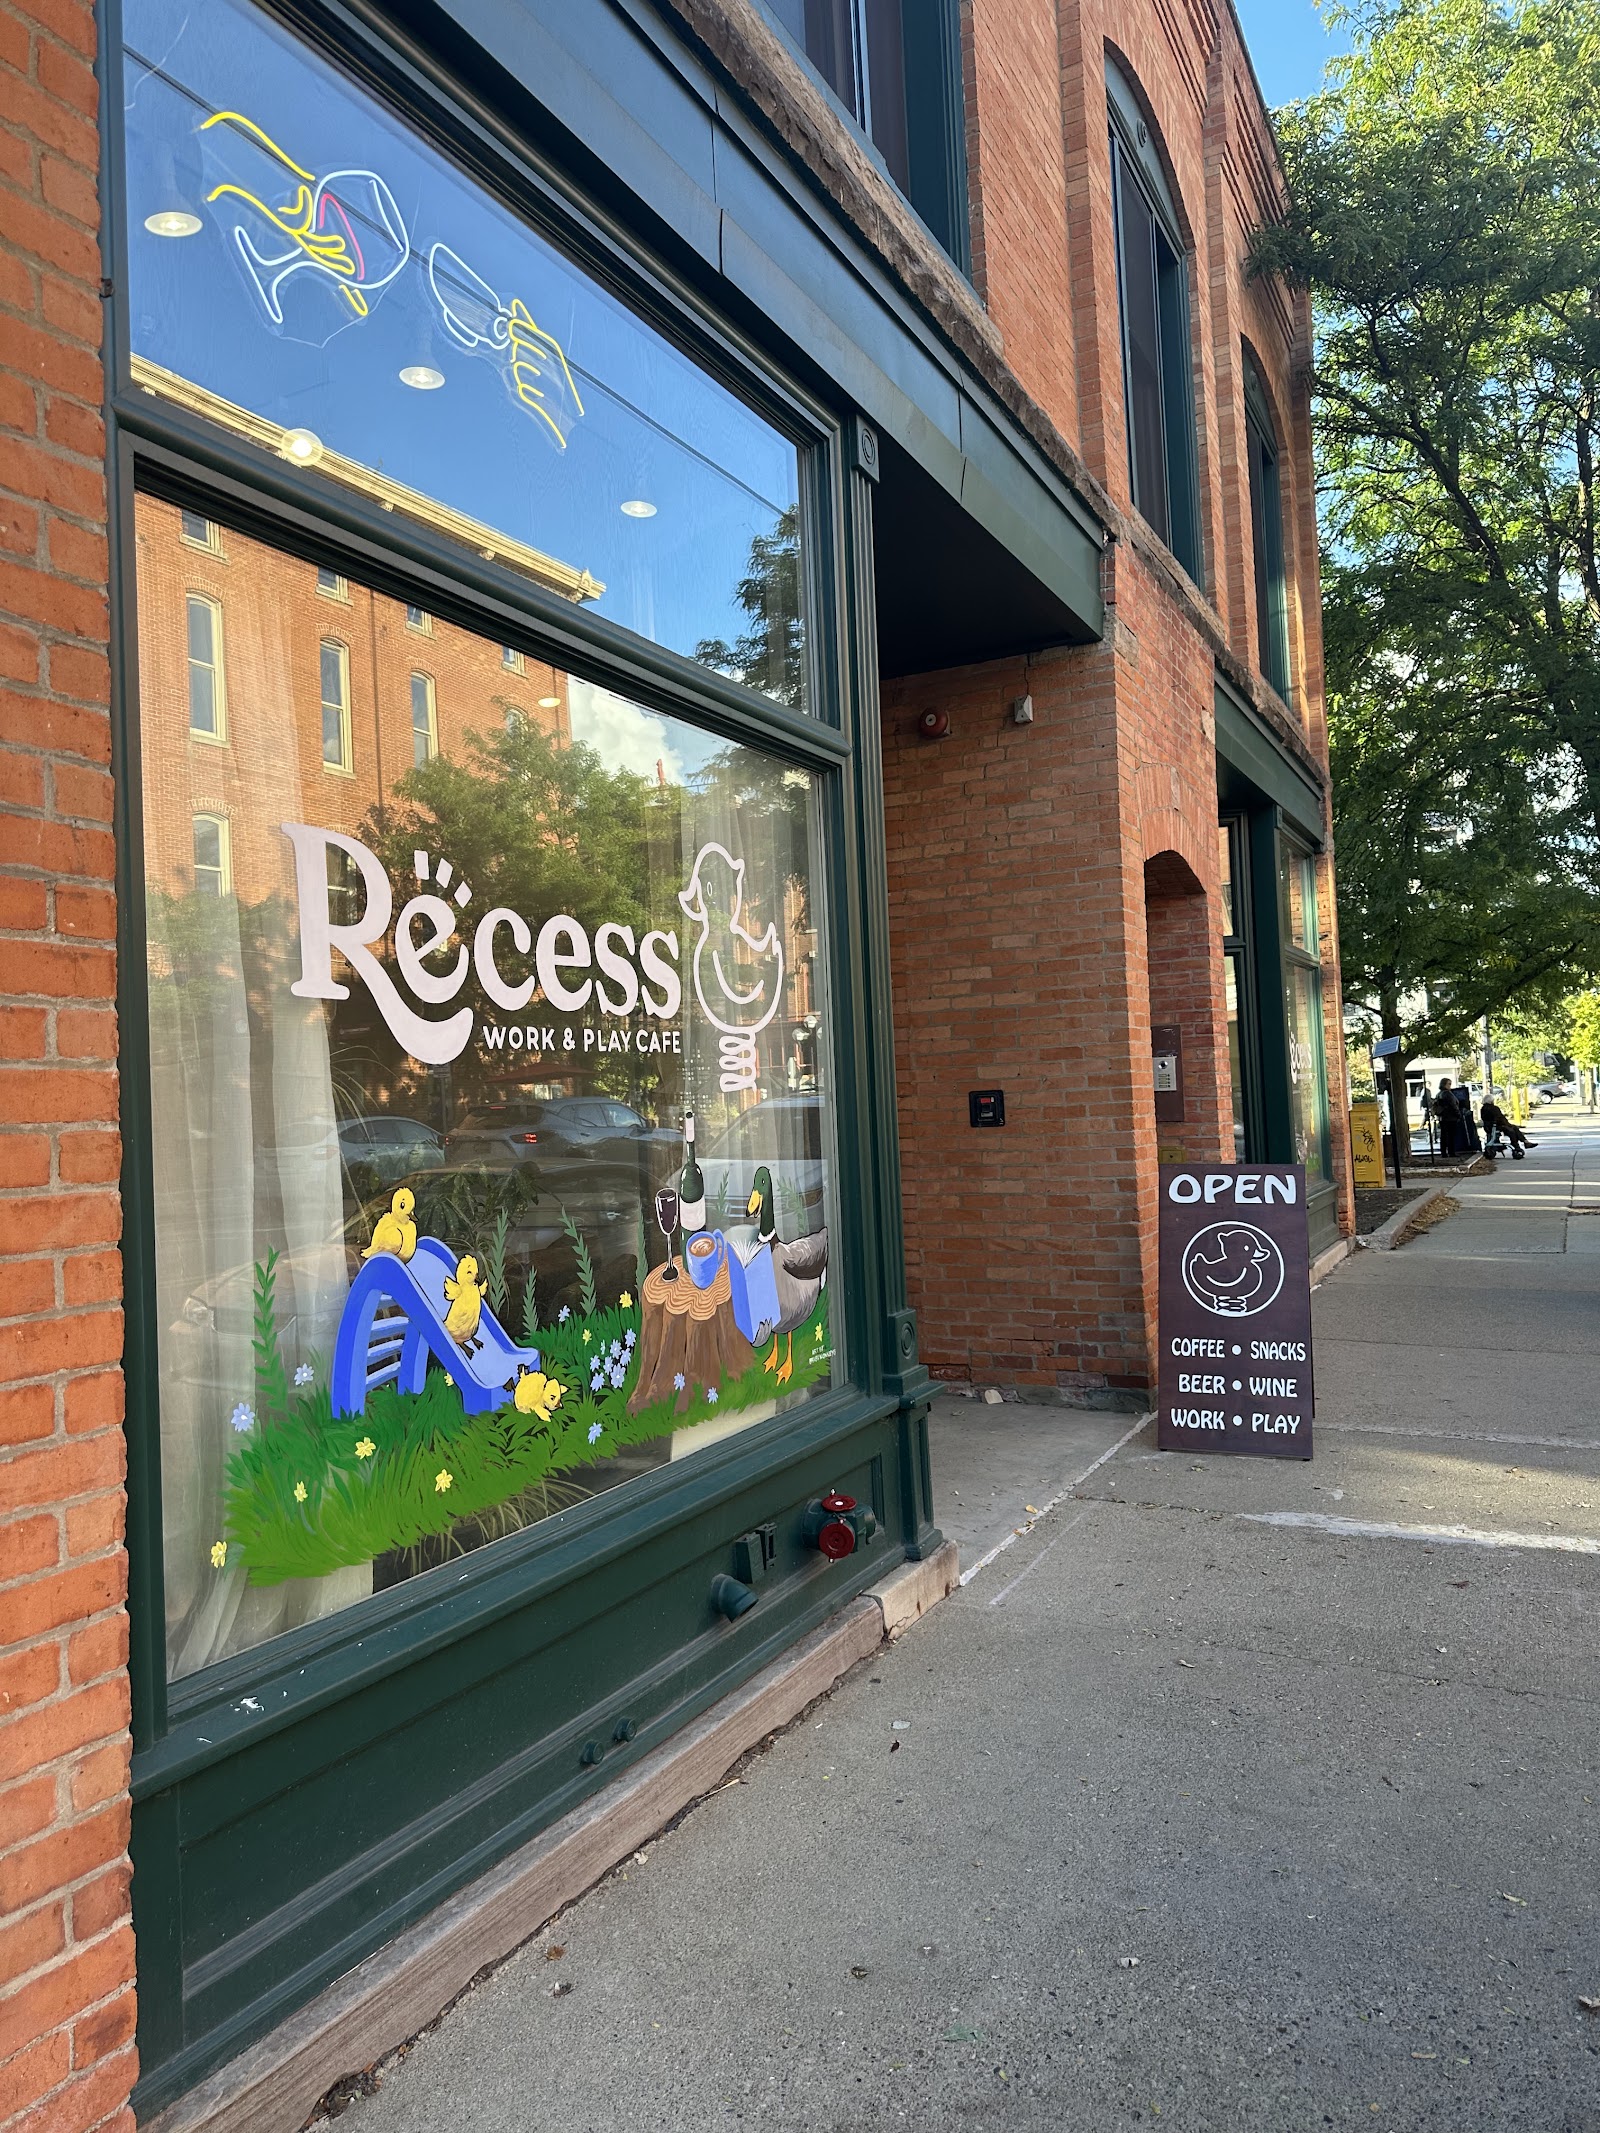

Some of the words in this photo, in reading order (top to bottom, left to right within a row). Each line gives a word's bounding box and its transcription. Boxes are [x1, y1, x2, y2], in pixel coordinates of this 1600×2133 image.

[281, 822, 682, 1065] Recess
[482, 1025, 556, 1051] WORK
[562, 1027, 576, 1051] &
[583, 1028, 631, 1053] PLAY
[636, 1028, 682, 1054] CAFE
[1168, 1173, 1297, 1205] OPEN
[1171, 1337, 1226, 1358] COFFEE
[1250, 1340, 1306, 1362] SNACKS
[1178, 1373, 1226, 1395] BEER
[1249, 1377, 1298, 1398] WINE
[1170, 1408, 1226, 1431] WORK
[1251, 1412, 1301, 1435] PLAY
